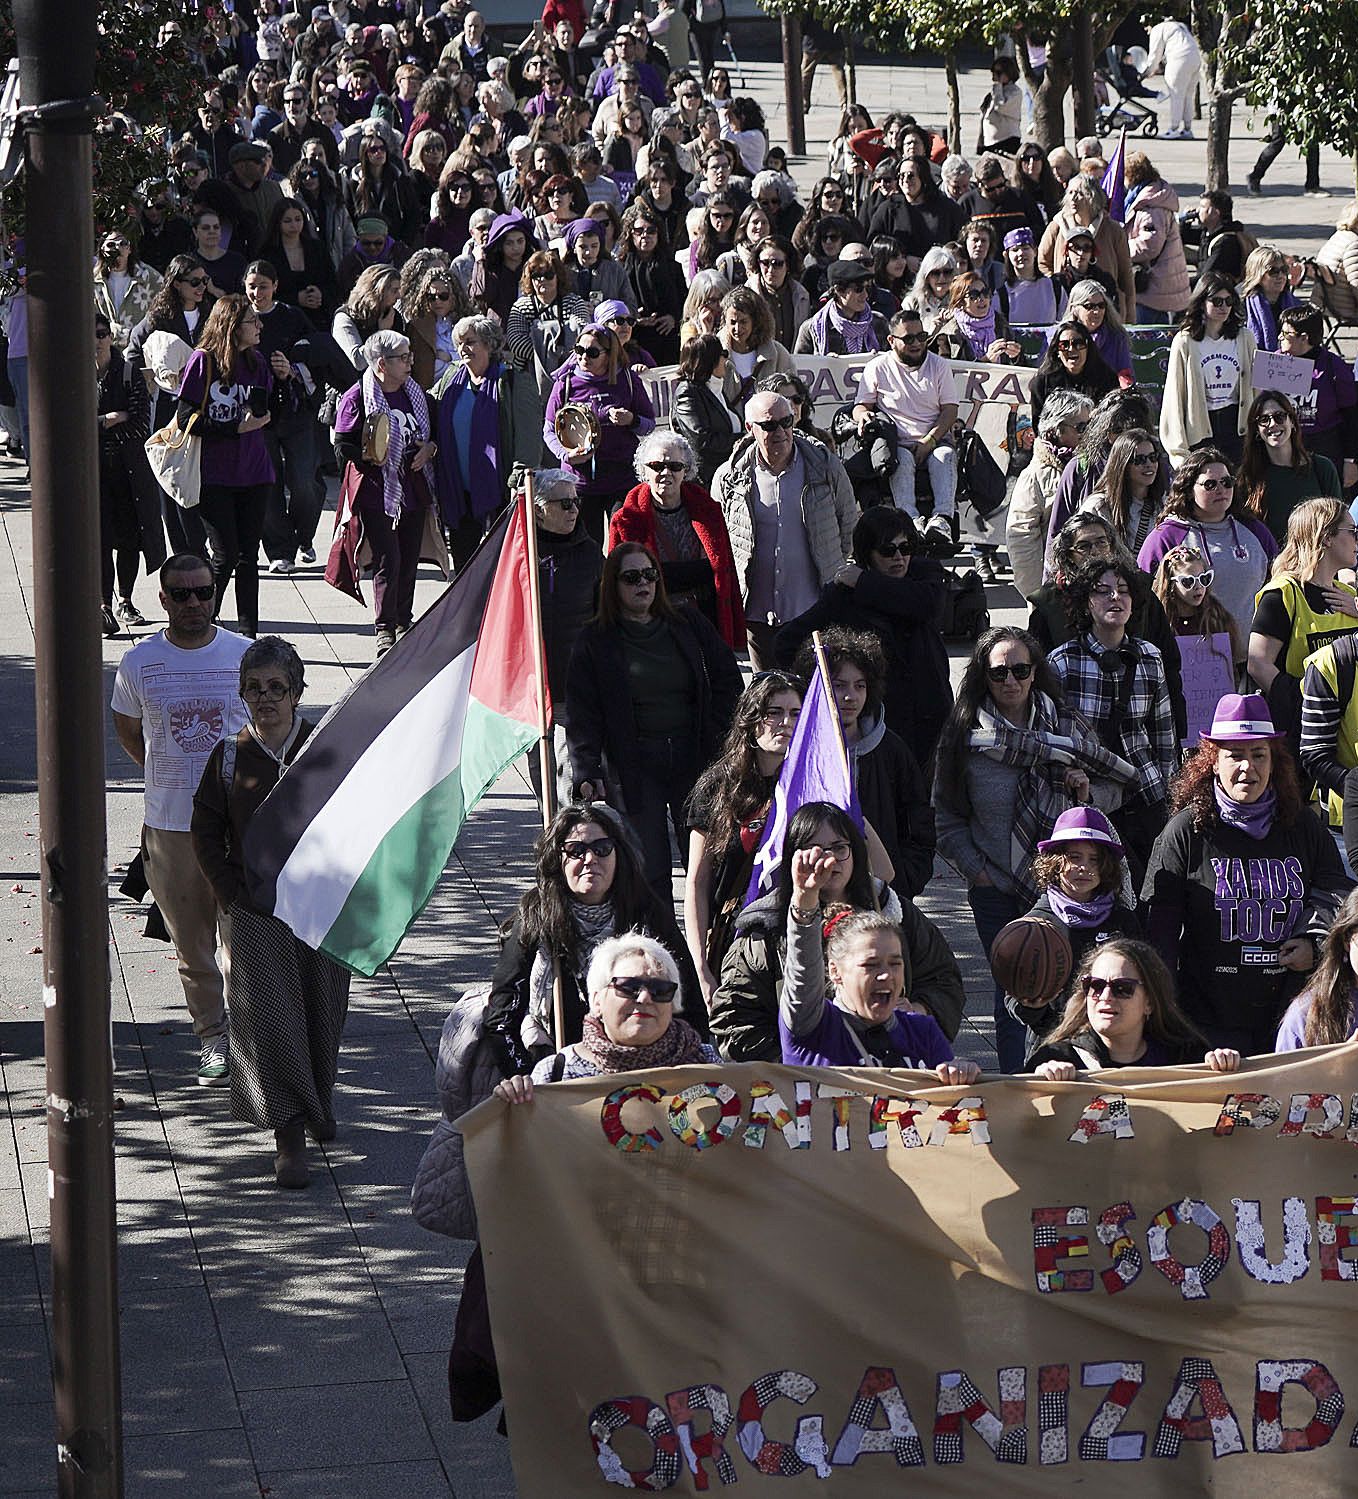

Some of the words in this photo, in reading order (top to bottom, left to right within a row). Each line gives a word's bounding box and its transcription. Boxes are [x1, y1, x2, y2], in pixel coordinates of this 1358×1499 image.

[1248, 855, 1305, 899] NOS
[600, 1080, 993, 1153] CONTRA
[1066, 1093, 1134, 1146] A
